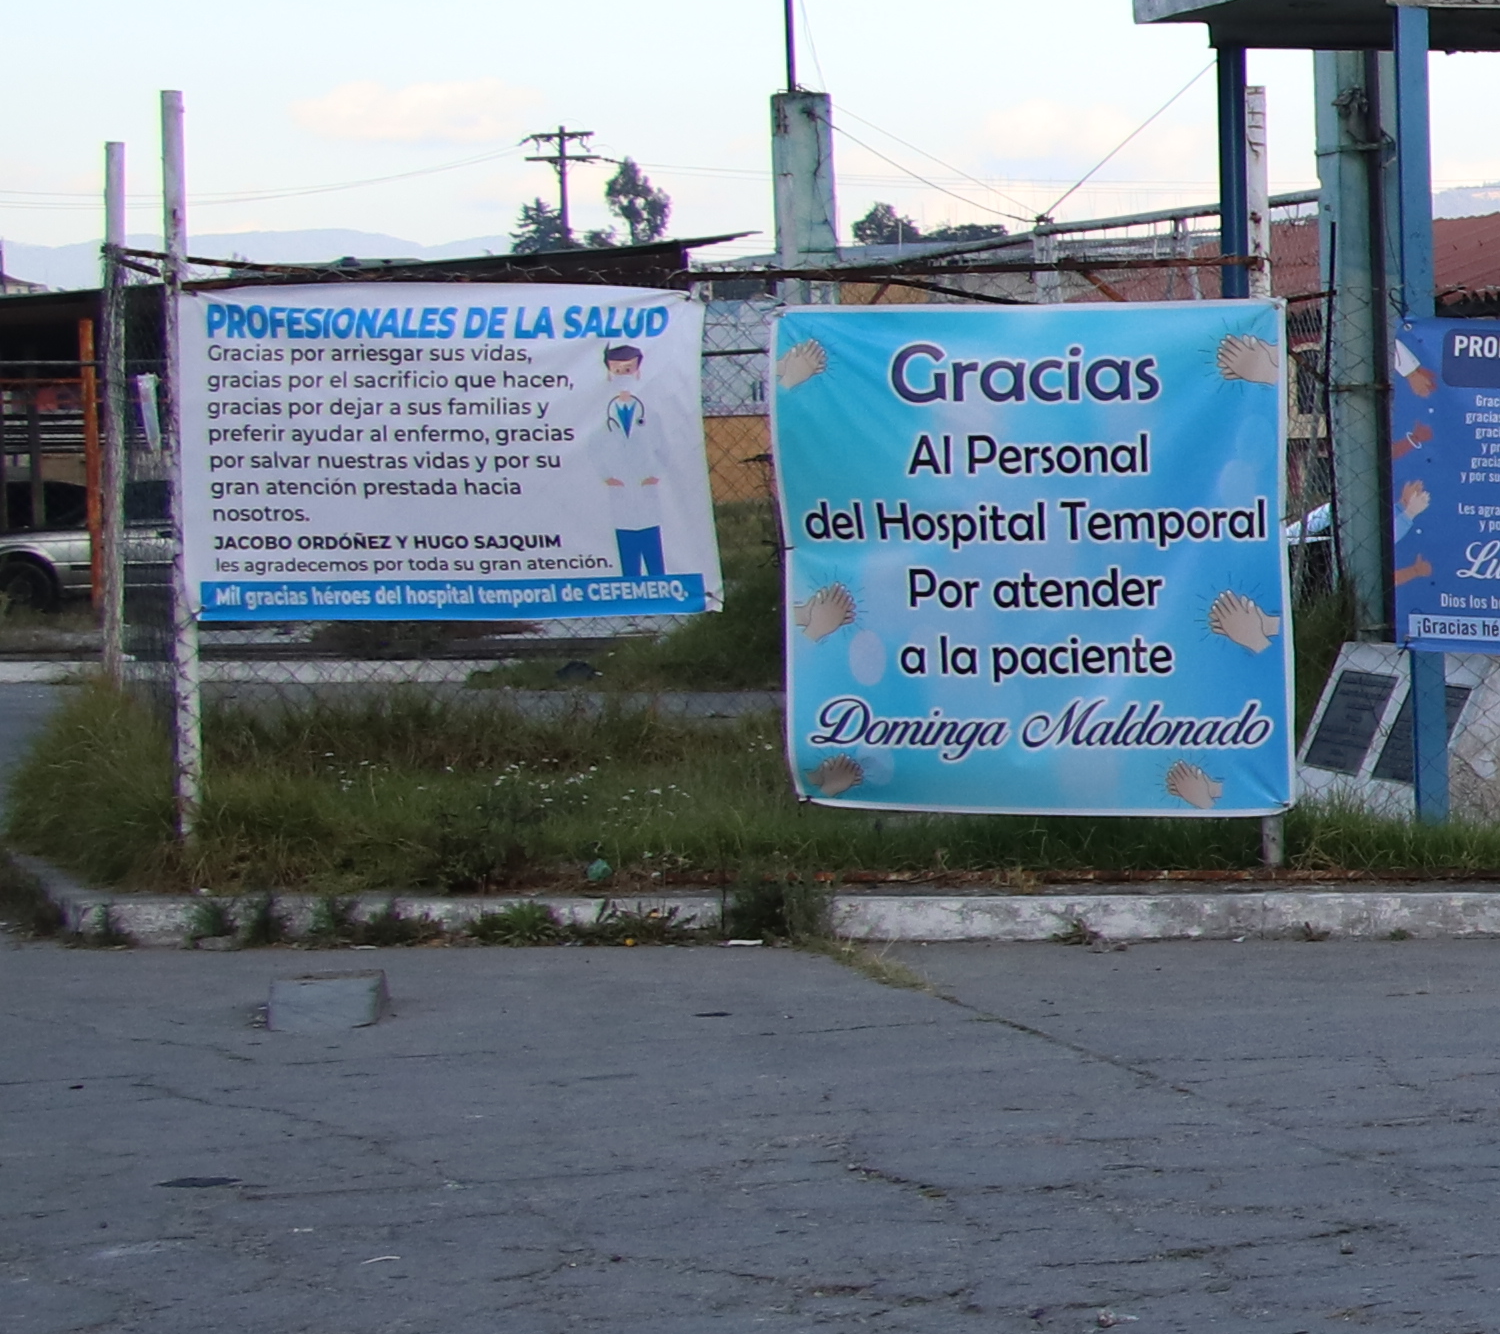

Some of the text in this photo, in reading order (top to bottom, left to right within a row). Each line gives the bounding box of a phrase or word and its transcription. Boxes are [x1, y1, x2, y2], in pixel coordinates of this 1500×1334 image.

[206, 304, 668, 339] PROFESIONALES DE LA SALUD
[208, 344, 532, 365] Gracias por arriesgar sus vidas,
[208, 370, 573, 392] gracias por el sacrificio que hacen,
[889, 345, 1159, 407] Gracias
[208, 397, 548, 419] gracias por dejar a sus familias y
[209, 424, 574, 446] preferir ayudar al enfermo, gracias
[210, 451, 560, 473] por salvar nuestras vidas y por su
[909, 434, 1147, 474] Al Personal
[211, 477, 521, 499] gran atención prestada hacia
[1461, 472, 1466, 483] y
[1469, 472, 1486, 483] por
[1489, 473, 1500, 482] su
[213, 507, 309, 521] nosotros.
[1458, 503, 1475, 514] Les
[805, 496, 1264, 549] del Hospital Temporal
[215, 533, 561, 551] JACOBO ORDÓÑEZ Y HUGO SAJQUIM
[216, 554, 613, 575] les agradecemos por toda su gran atención.
[216, 580, 688, 610] Mil gracias héroes del hospital temporal de CEFEMERQ.
[909, 568, 1162, 608] Por atender
[1441, 593, 1466, 608] Dios
[1470, 595, 1487, 609] los
[1417, 618, 1477, 636] ¡Gracias
[901, 636, 1172, 682] a la paciente
[810, 698, 1008, 761] Dominga
[1022, 699, 1272, 749] Maldonado
